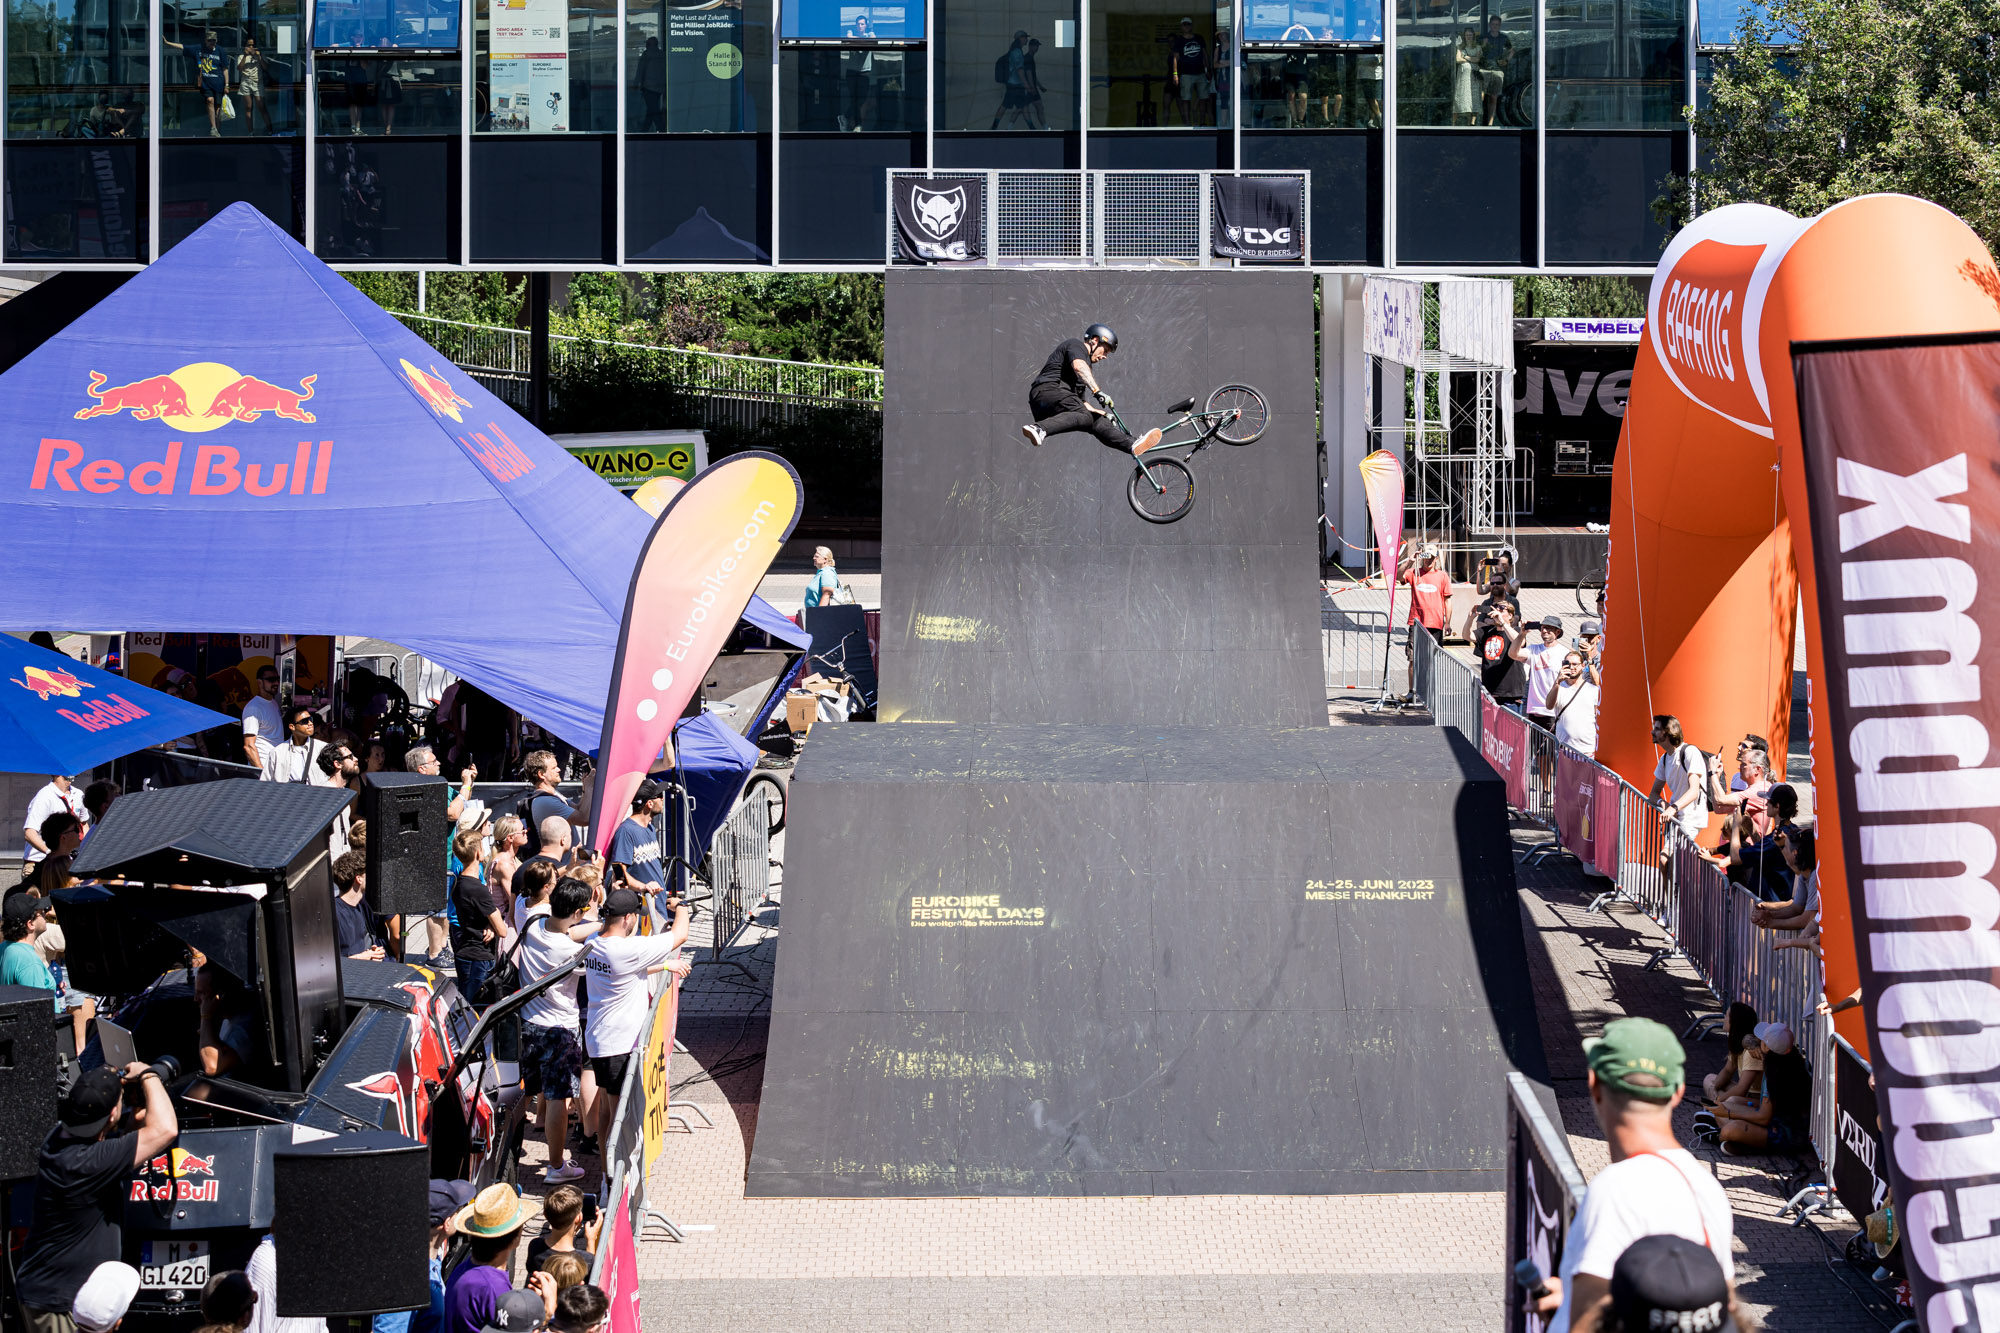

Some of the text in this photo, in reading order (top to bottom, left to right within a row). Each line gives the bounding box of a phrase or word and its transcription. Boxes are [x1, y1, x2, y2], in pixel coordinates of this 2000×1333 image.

[1243, 227, 1291, 245] TSG
[1224, 246, 1256, 256] DESIGNED
[1562, 322, 1645, 334] BEMBEL
[1666, 279, 1735, 381] BAFANG
[29, 438, 334, 497] Red Bull
[666, 499, 776, 662] Eurobike.com
[135, 632, 162, 646] Red
[243, 636, 269, 649] Bull
[1359, 880, 1394, 889] JUNI
[1397, 880, 1434, 889] 2023
[911, 895, 1000, 907] EUROBIKE
[1305, 891, 1434, 900] MESSE FRANKFURT
[911, 908, 1045, 919] FESTIVAL DAYS
[131, 1180, 219, 1201] Red Bull
[169, 1244, 180, 1262] M
